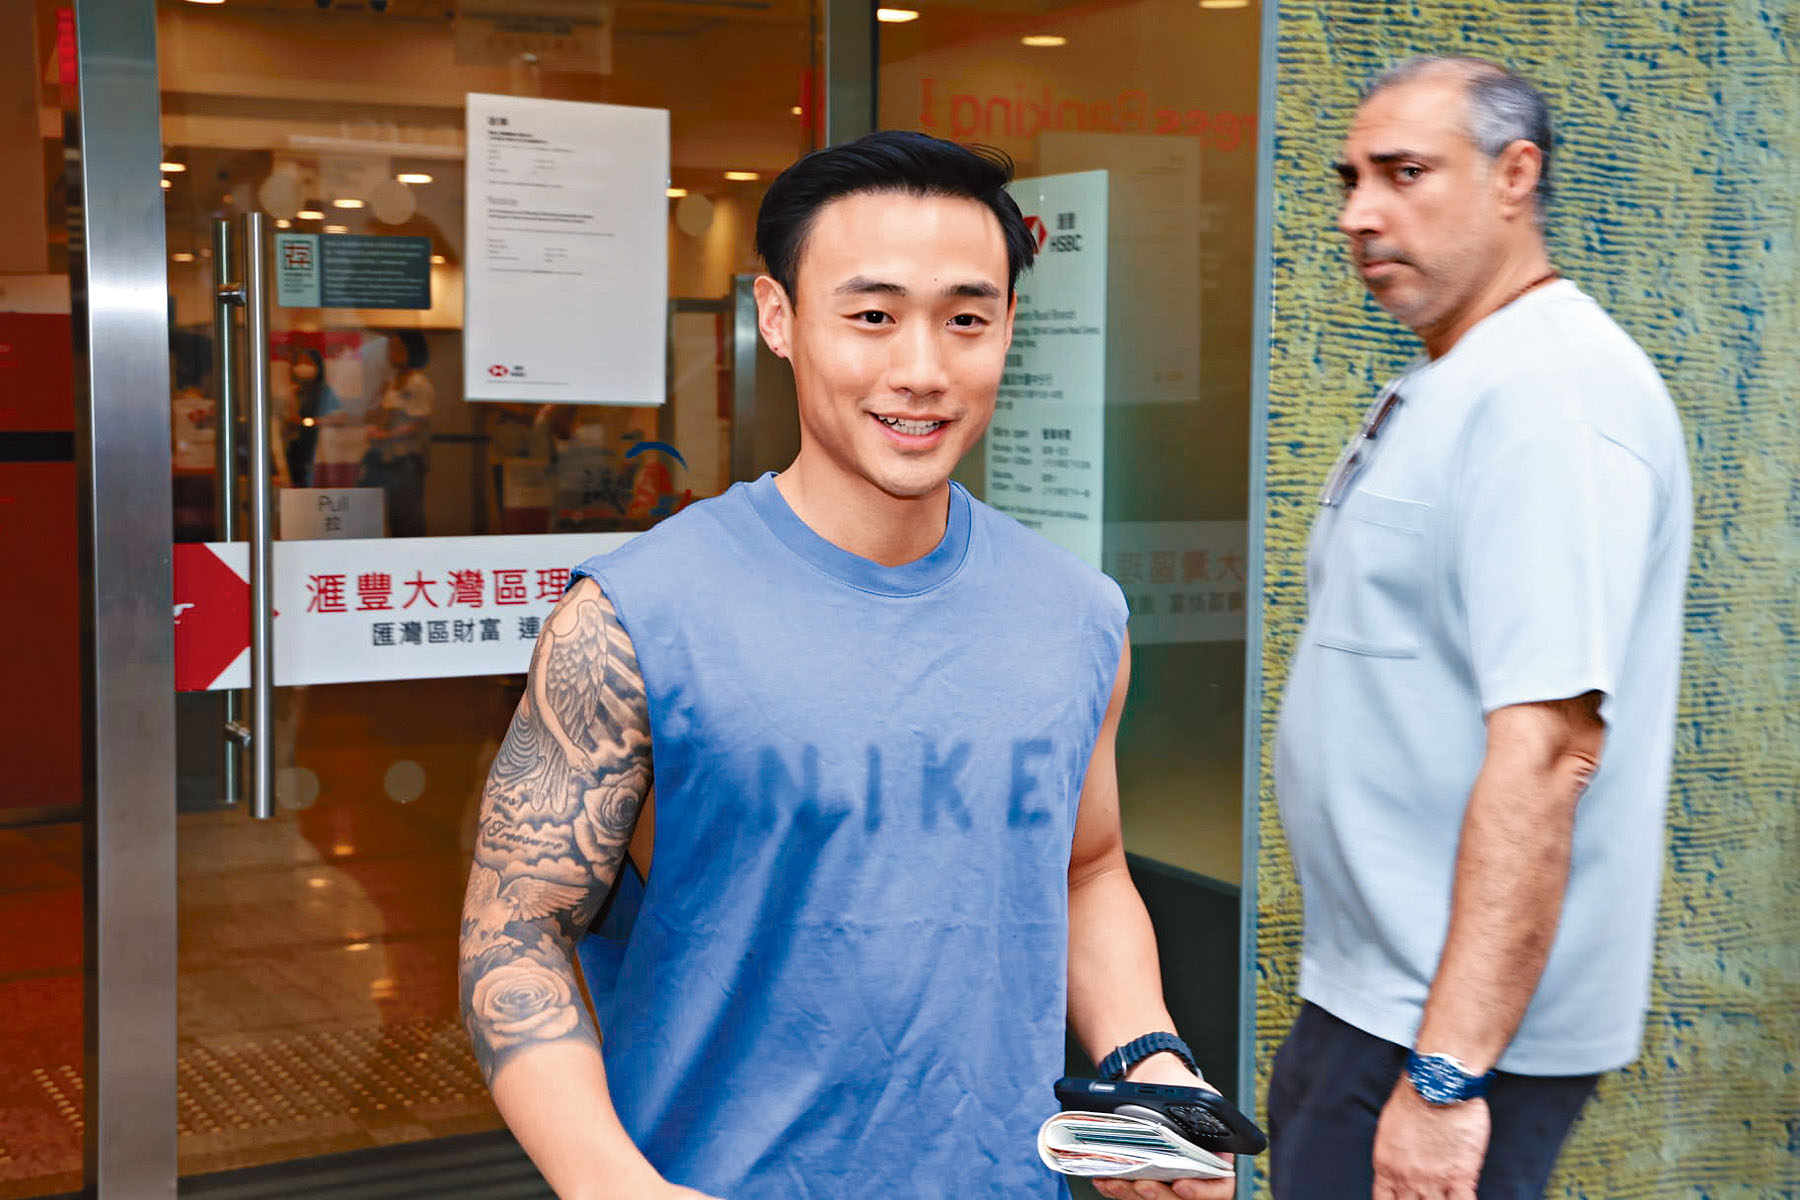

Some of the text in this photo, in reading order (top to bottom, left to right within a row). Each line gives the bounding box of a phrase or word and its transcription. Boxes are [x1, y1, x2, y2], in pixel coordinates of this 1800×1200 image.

[1049, 234, 1082, 252] HSBC
[318, 495, 350, 512] Pull
[757, 737, 1054, 835] NIKE
